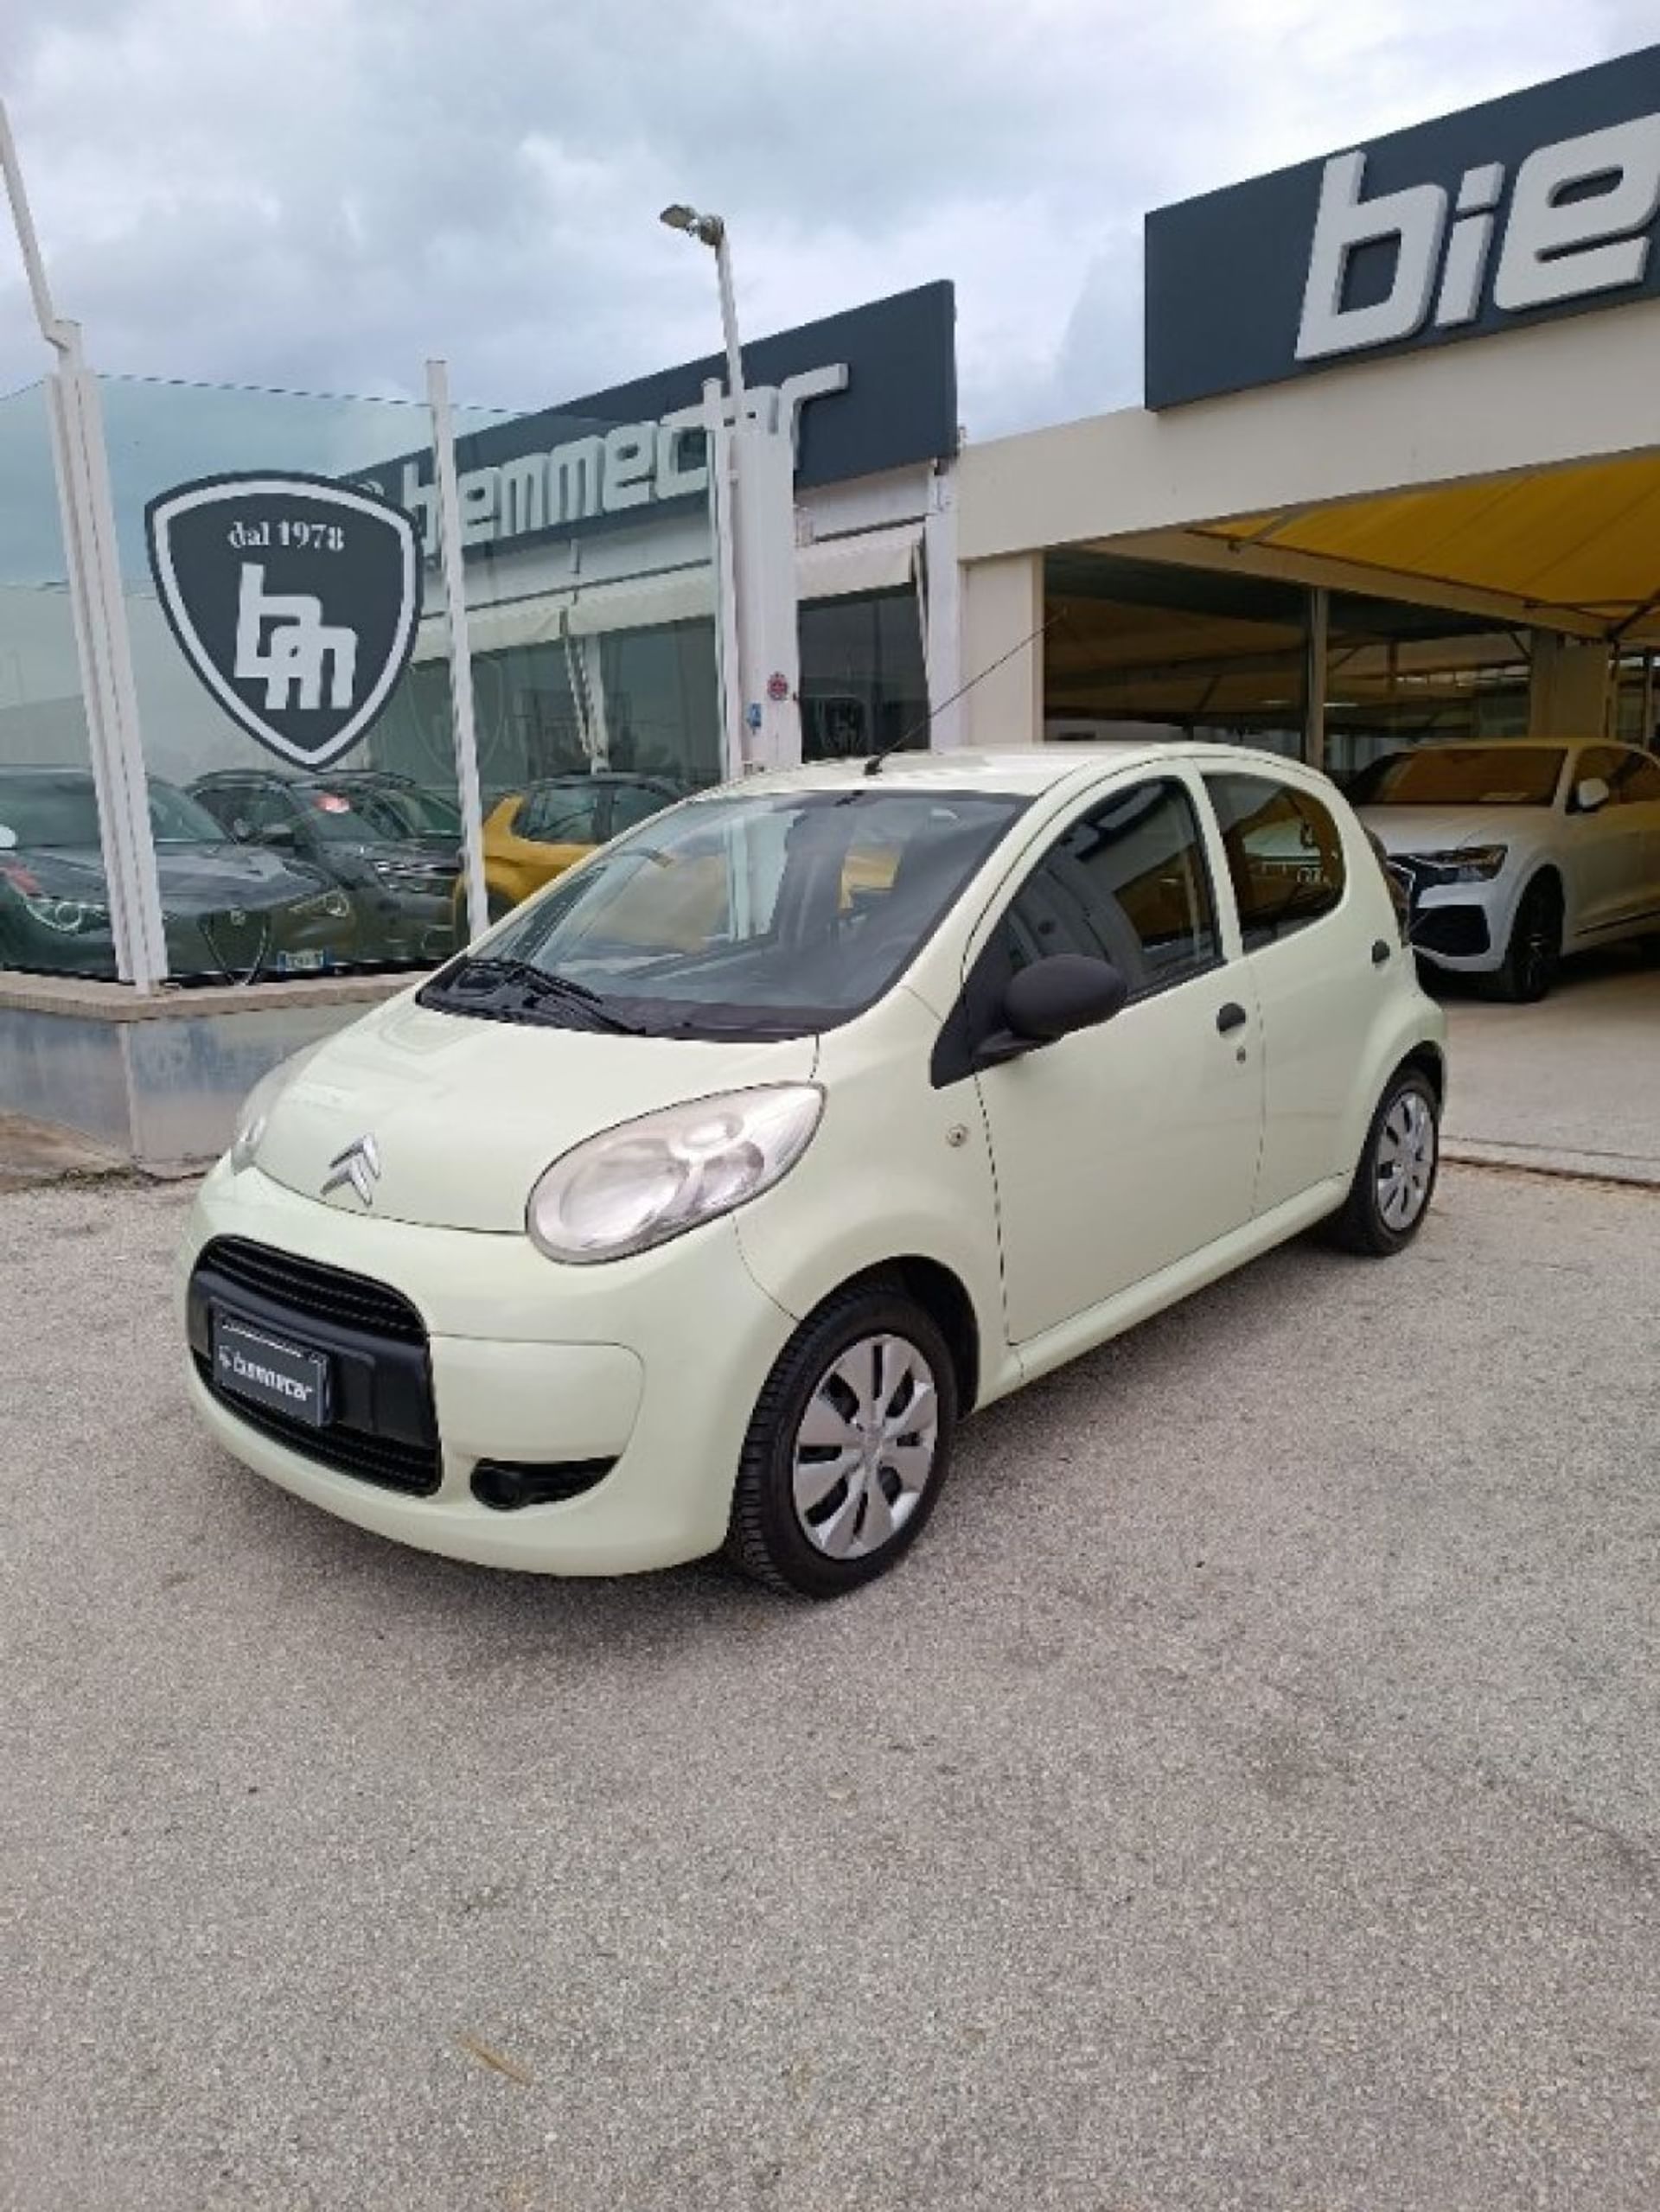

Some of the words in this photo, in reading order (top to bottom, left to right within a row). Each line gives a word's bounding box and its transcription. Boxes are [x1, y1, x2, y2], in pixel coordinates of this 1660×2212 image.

[403, 362, 851, 558] bemmecr
[227, 521, 270, 548] dal
[278, 520, 345, 552] 1978
